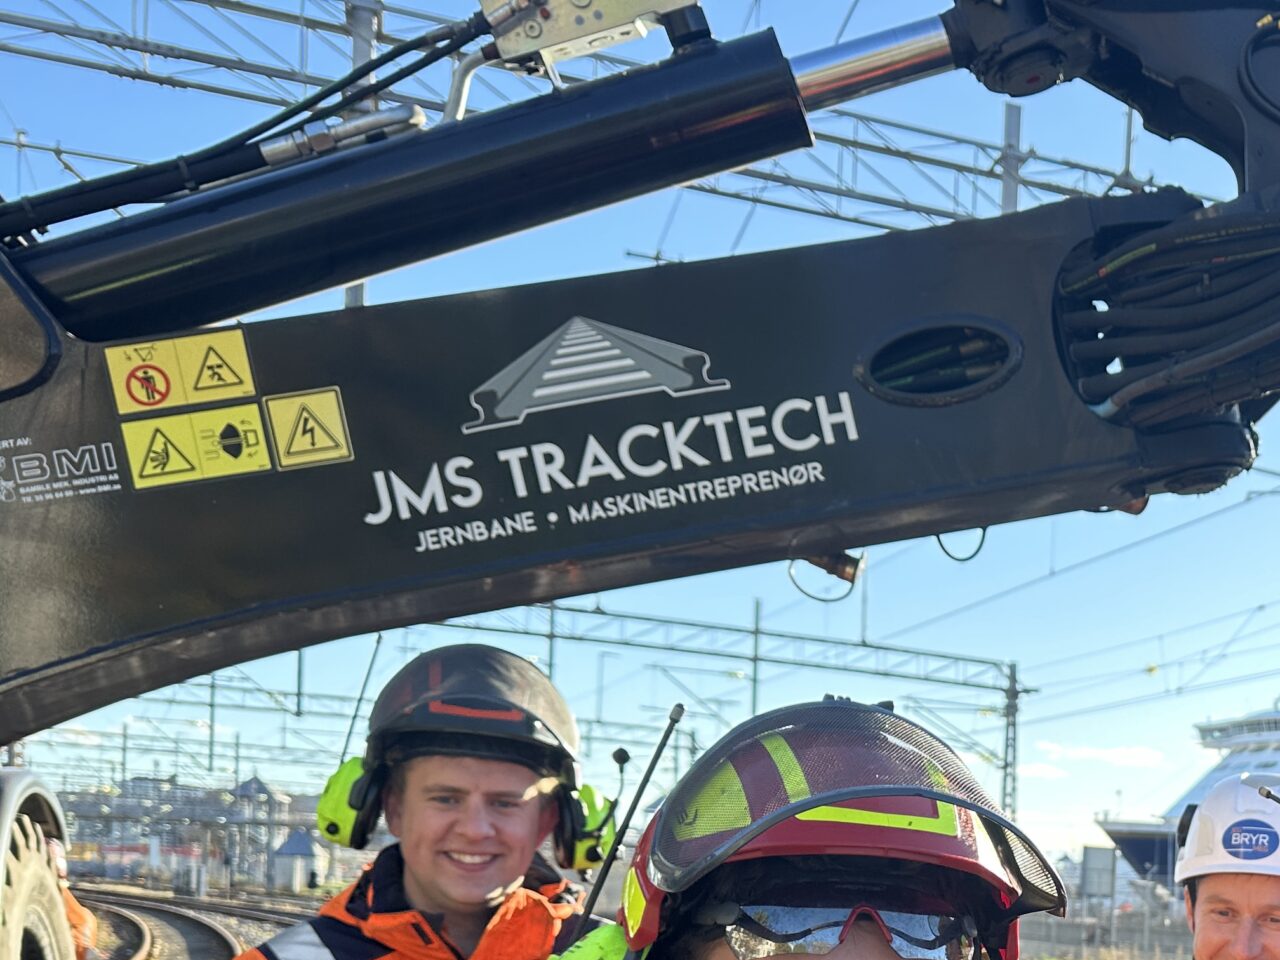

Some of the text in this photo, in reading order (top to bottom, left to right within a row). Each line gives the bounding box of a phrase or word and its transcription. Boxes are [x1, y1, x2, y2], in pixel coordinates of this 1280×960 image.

[12, 442, 117, 484] BMI
[363, 392, 859, 525] JMS TRACKTECH
[414, 462, 825, 552] JERNBANE MASKINENTREPRENØR
[1231, 832, 1269, 846] BRYR
